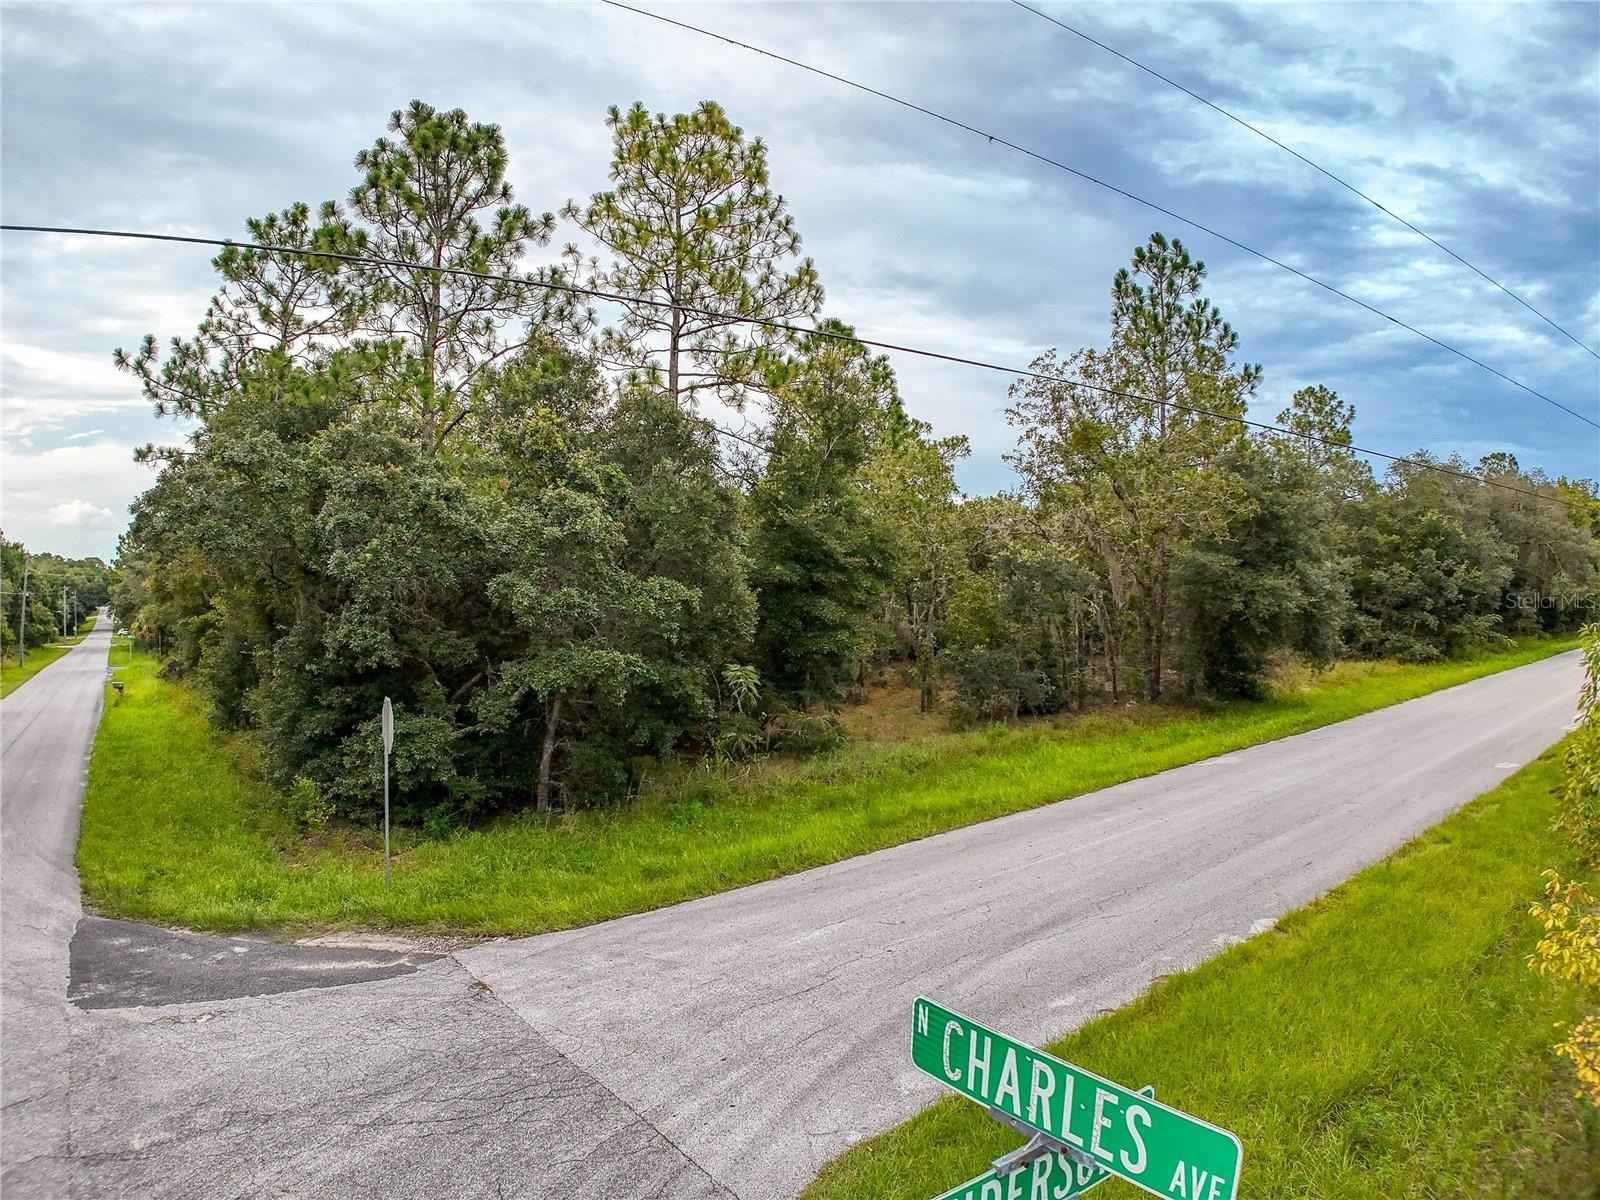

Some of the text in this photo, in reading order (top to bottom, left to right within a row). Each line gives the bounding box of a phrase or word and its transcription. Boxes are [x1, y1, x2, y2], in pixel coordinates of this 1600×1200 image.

[917, 1004, 1226, 1200] N CHARLES AVE
